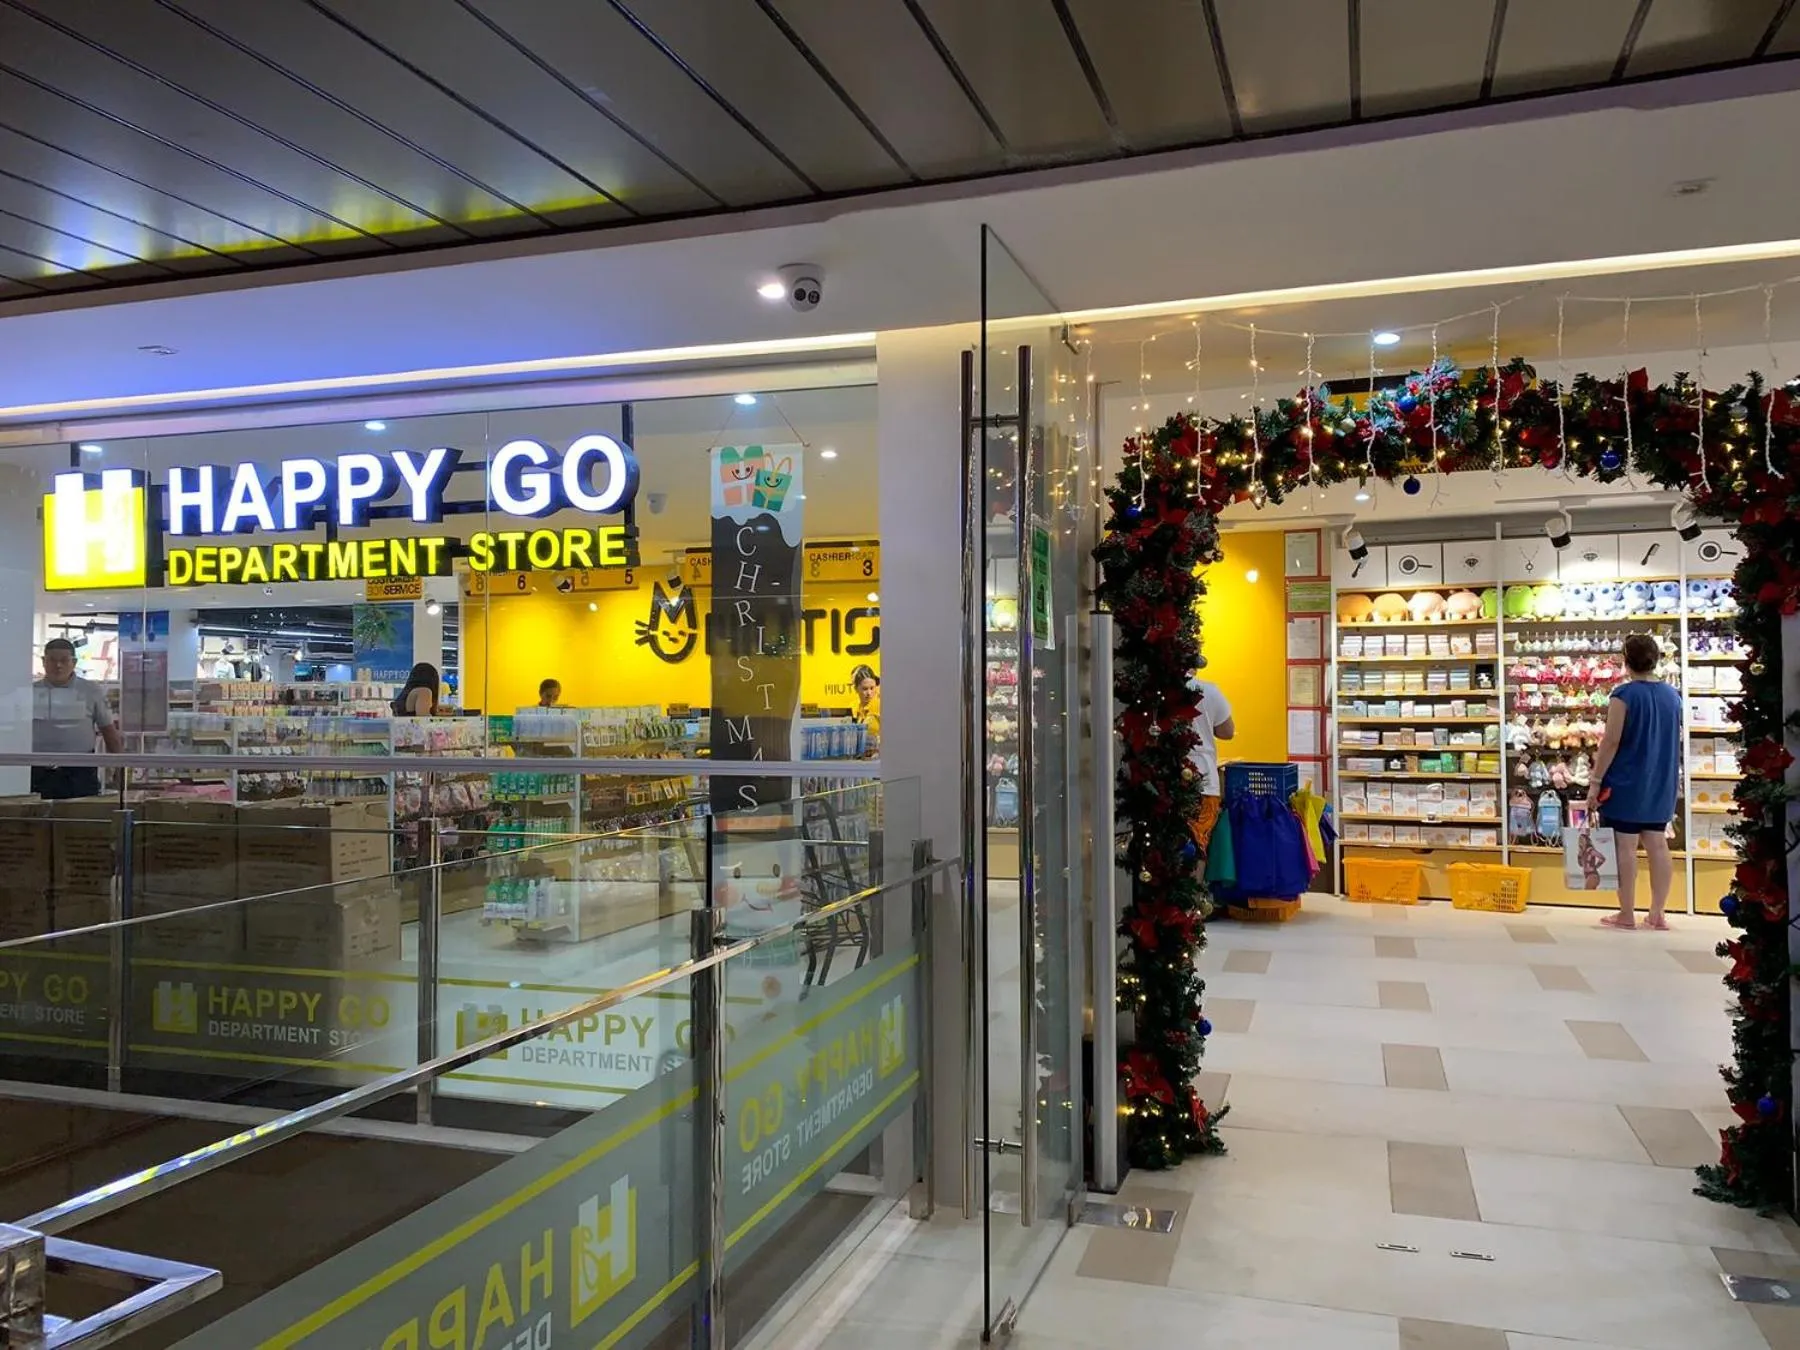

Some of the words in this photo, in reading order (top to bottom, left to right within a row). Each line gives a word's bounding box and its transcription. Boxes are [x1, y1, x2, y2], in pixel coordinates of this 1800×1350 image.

[168, 446, 450, 536] HAPPY
[490, 433, 629, 517] GO
[168, 536, 446, 586] DEPARTMENT
[467, 525, 629, 572] STORE
[690, 557, 712, 567] CASH
[624, 568, 634, 585] 5
[862, 559, 874, 577] 3
[384, 584, 421, 595] SERVICE
[516, 574, 527, 590] 6
[43, 973, 88, 1004] GO
[35, 1005, 85, 1025] STORE
[208, 985, 322, 1022] HAPPY
[338, 993, 390, 1028] GO
[208, 1020, 321, 1045] DEPARTMENT
[521, 1046, 653, 1073] DEPARTMENT
